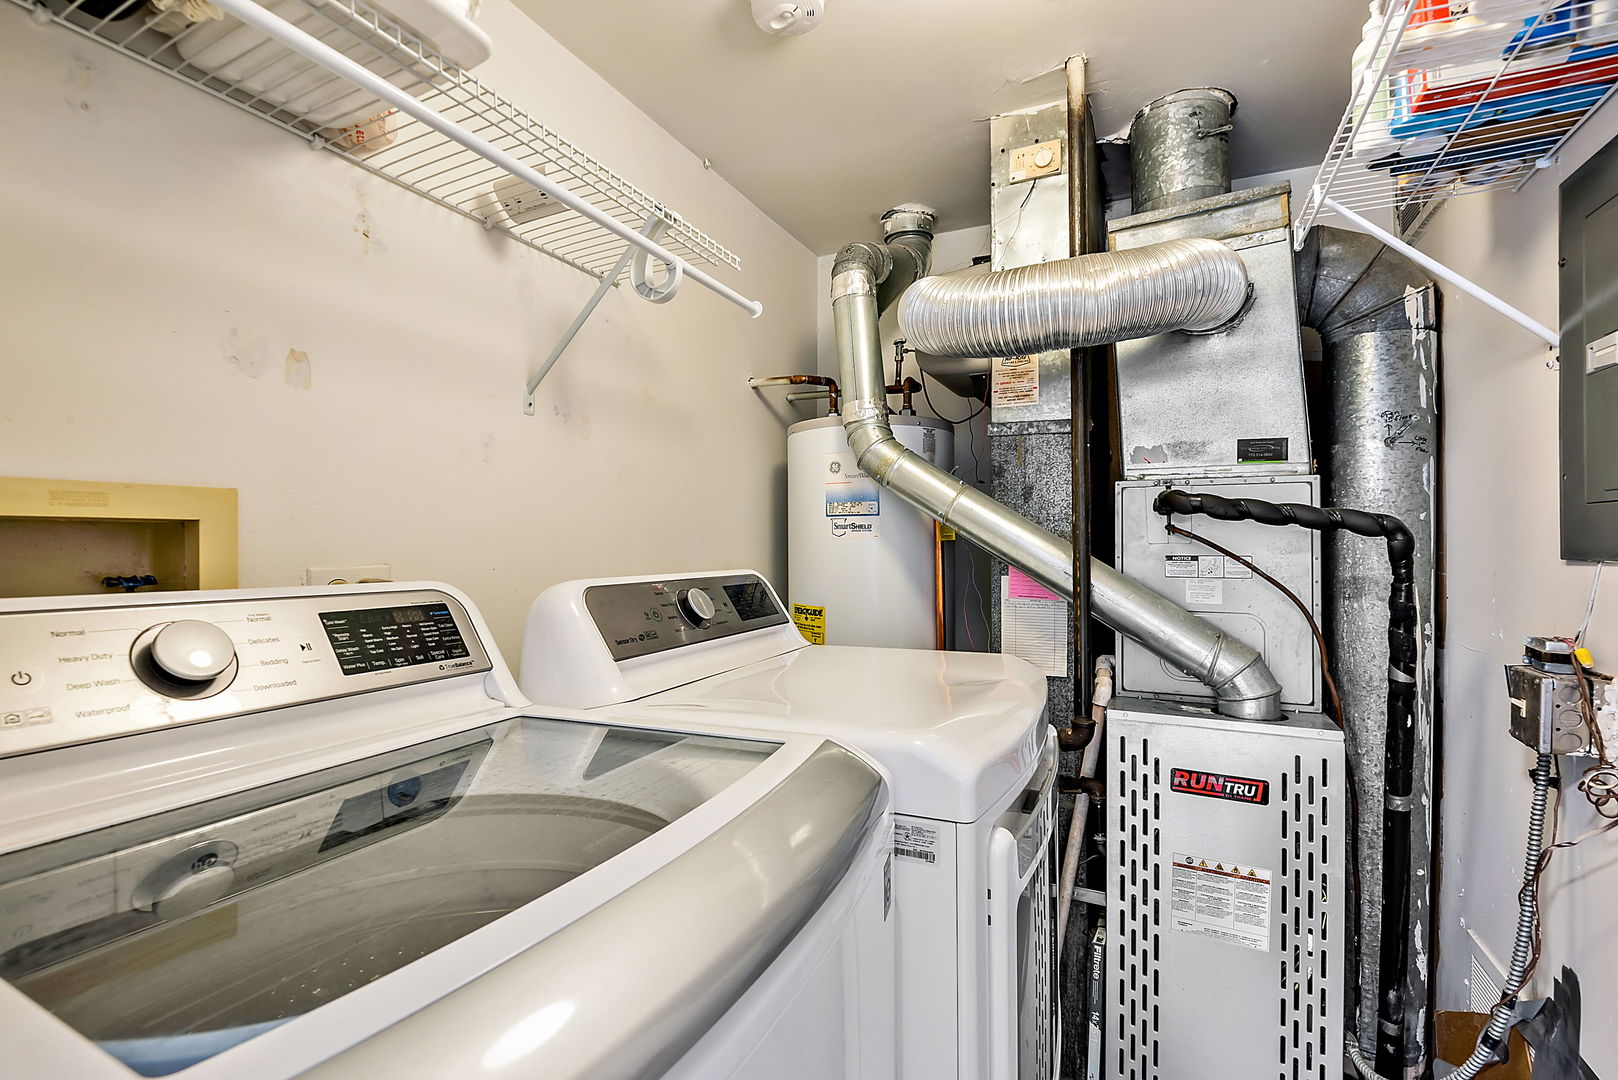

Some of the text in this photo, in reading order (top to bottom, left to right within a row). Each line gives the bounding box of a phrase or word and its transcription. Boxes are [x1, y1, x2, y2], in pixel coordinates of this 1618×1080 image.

[246, 616, 272, 624] Normal
[50, 629, 86, 638] Normal
[248, 637, 281, 646] Delicates
[58, 652, 113, 663] Heavy Duty
[260, 657, 289, 667] Bedding
[66, 678, 120, 691] Deep Wash
[253, 679, 297, 692] Downloaded
[75, 703, 131, 718] Waterproof
[1092, 944, 1102, 980] Filtrete
